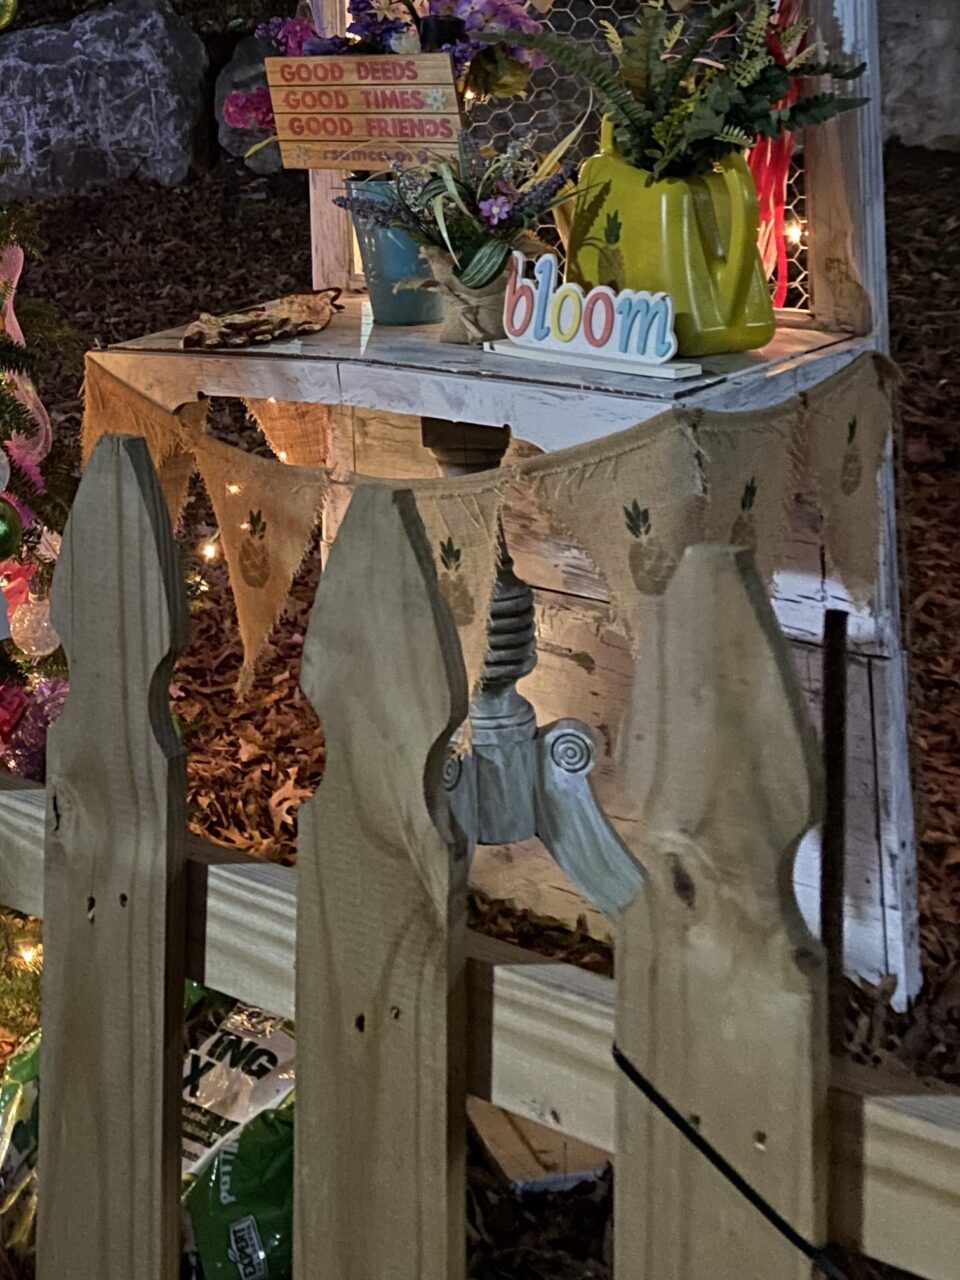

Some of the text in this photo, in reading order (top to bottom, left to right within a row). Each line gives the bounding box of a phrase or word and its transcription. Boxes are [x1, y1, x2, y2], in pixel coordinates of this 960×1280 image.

[280, 60, 418, 83] GOOD DEEDS
[283, 90, 425, 110] GOOD TIMES
[289, 116, 454, 138] GOOD FRIENDS
[505, 253, 672, 358] bloom
